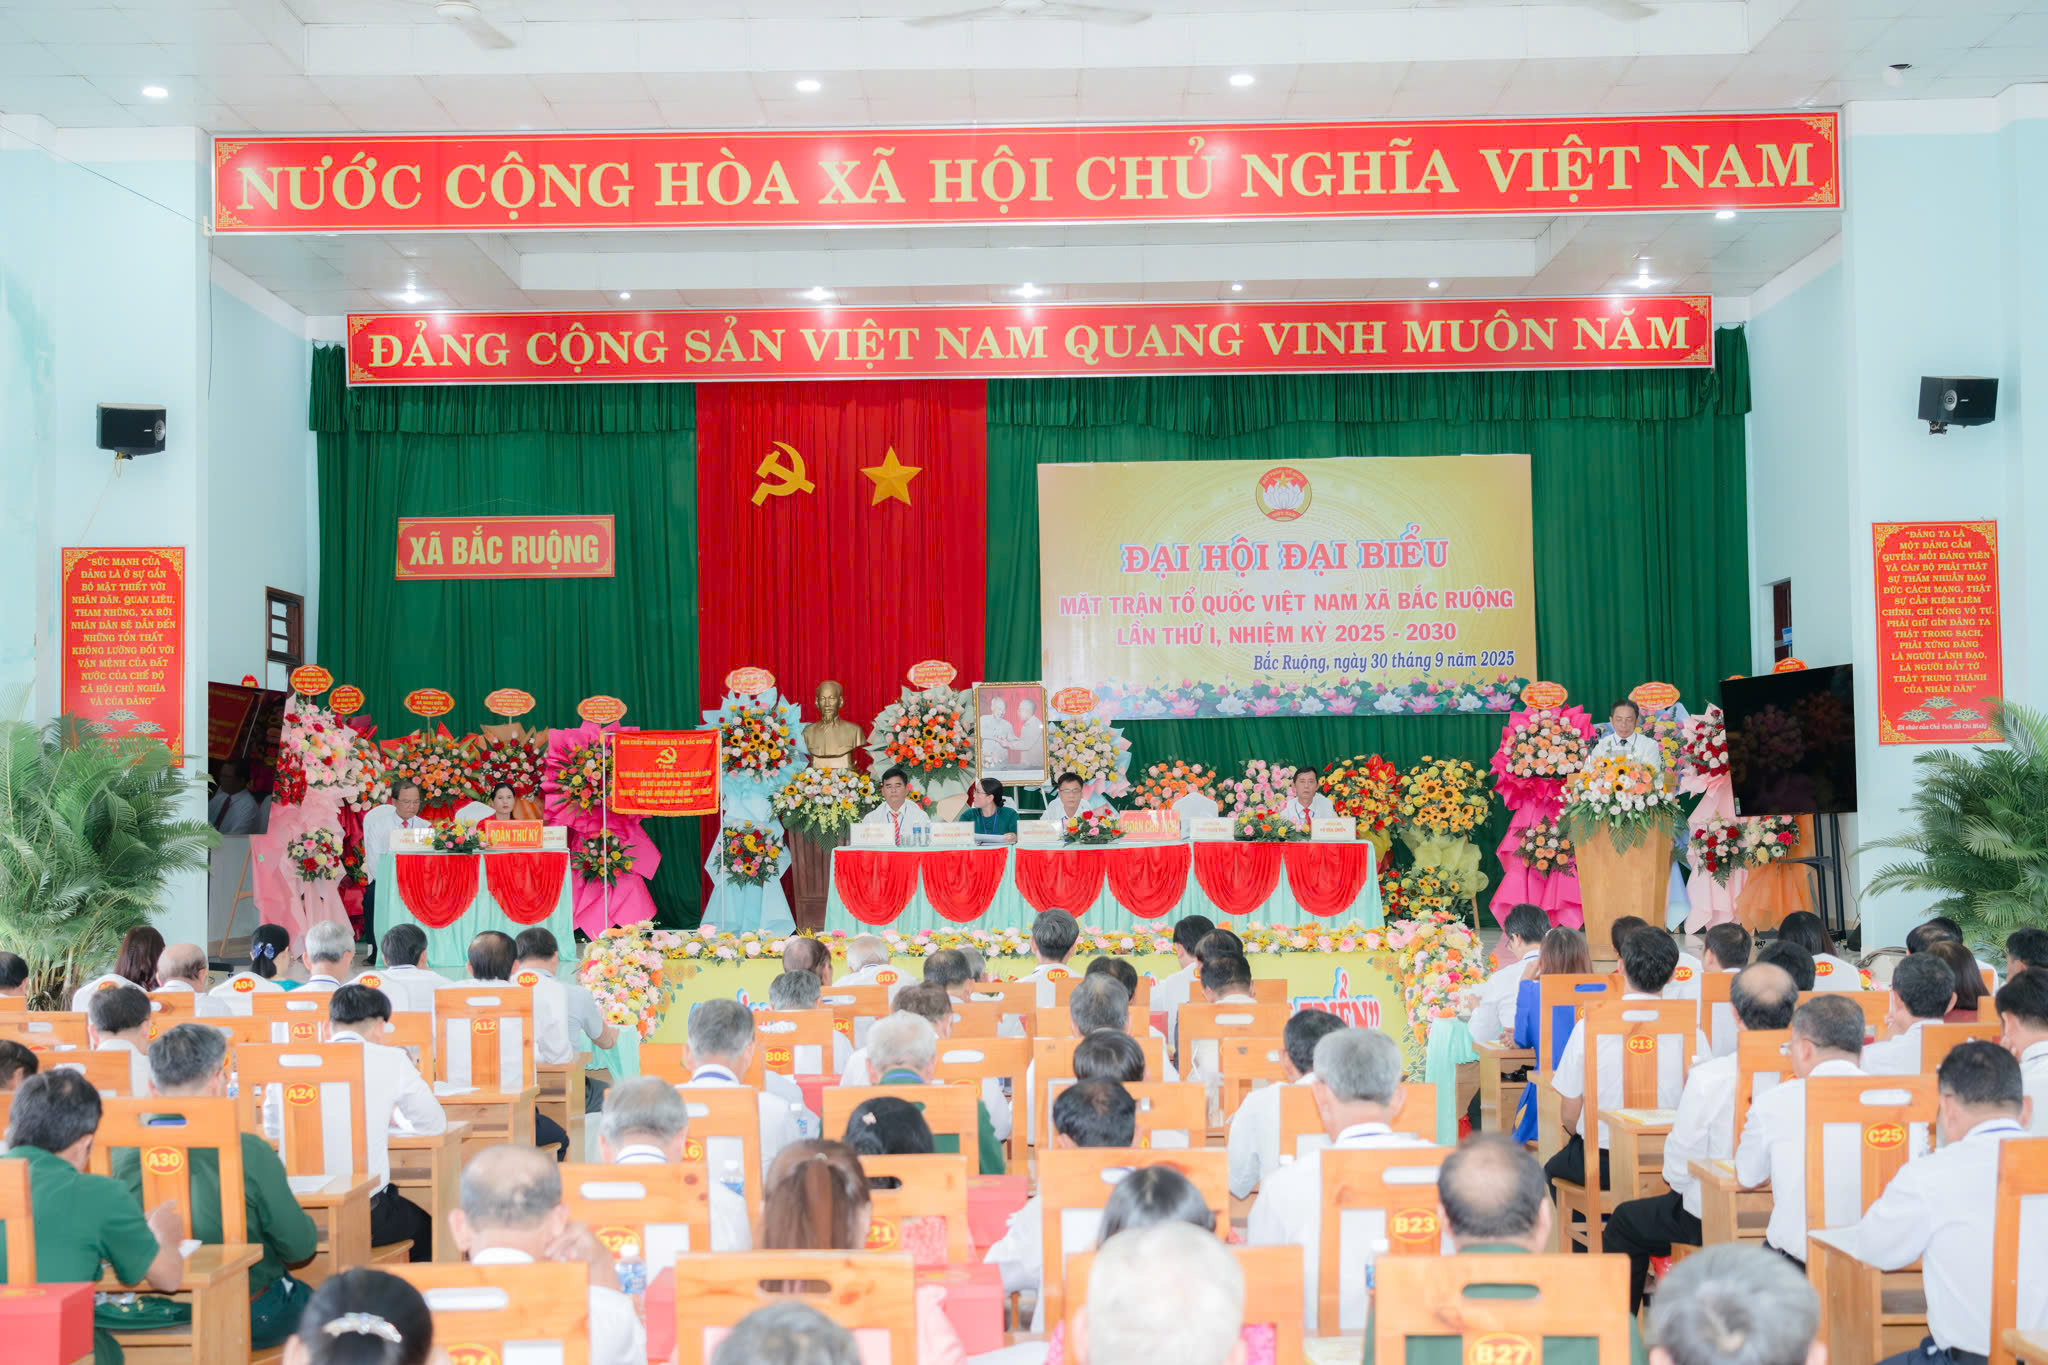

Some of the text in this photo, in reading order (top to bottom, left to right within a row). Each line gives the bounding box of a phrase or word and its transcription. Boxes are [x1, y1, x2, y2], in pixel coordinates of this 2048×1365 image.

[237, 135, 1816, 220] NƯỚC CỘNG HÒA XÃ HỘI CHỦ NGHĨA VIỆT NAM
[369, 309, 1691, 374] ĐẢNG CỘNG SẢN VIỆT NAM QUANG VINH MUÔN NĂM
[409, 525, 598, 570] XÃ BẮC RUỘNG
[1122, 523, 1448, 580] ĐẠI HỘI ĐẠI BIỂU
[1060, 585, 1512, 620] MẶT TRẬN TỔ QUỐC VIỆT NAM XÃ BẮC RUỘNG
[1117, 620, 1156, 645] LẦN
[1162, 623, 1204, 644] THỨ
[1210, 627, 1222, 648] I,
[1229, 622, 1294, 646] NHIỆM
[1301, 620, 1327, 642] KỲ
[1336, 624, 1385, 642] 2025
[1406, 623, 1456, 640] 2030
[1254, 650, 1514, 674] Bắc Ruộng, ngày 30 tháng 9 năm 2025
[512, 826, 528, 841] THƯ
[528, 826, 539, 841] KÝ
[235, 981, 254, 989] A04
[361, 978, 380, 986] A05
[878, 974, 896, 982] B01
[293, 1026, 312, 1034] A11
[475, 1022, 496, 1030] A12
[1630, 1039, 1652, 1050] C13
[765, 1052, 790, 1062] B08
[288, 1089, 314, 1100] A24
[1869, 1130, 1902, 1142] C25
[148, 1153, 179, 1166] A30
[1395, 1217, 1435, 1232] B23
[1476, 1345, 1528, 1365] B27
